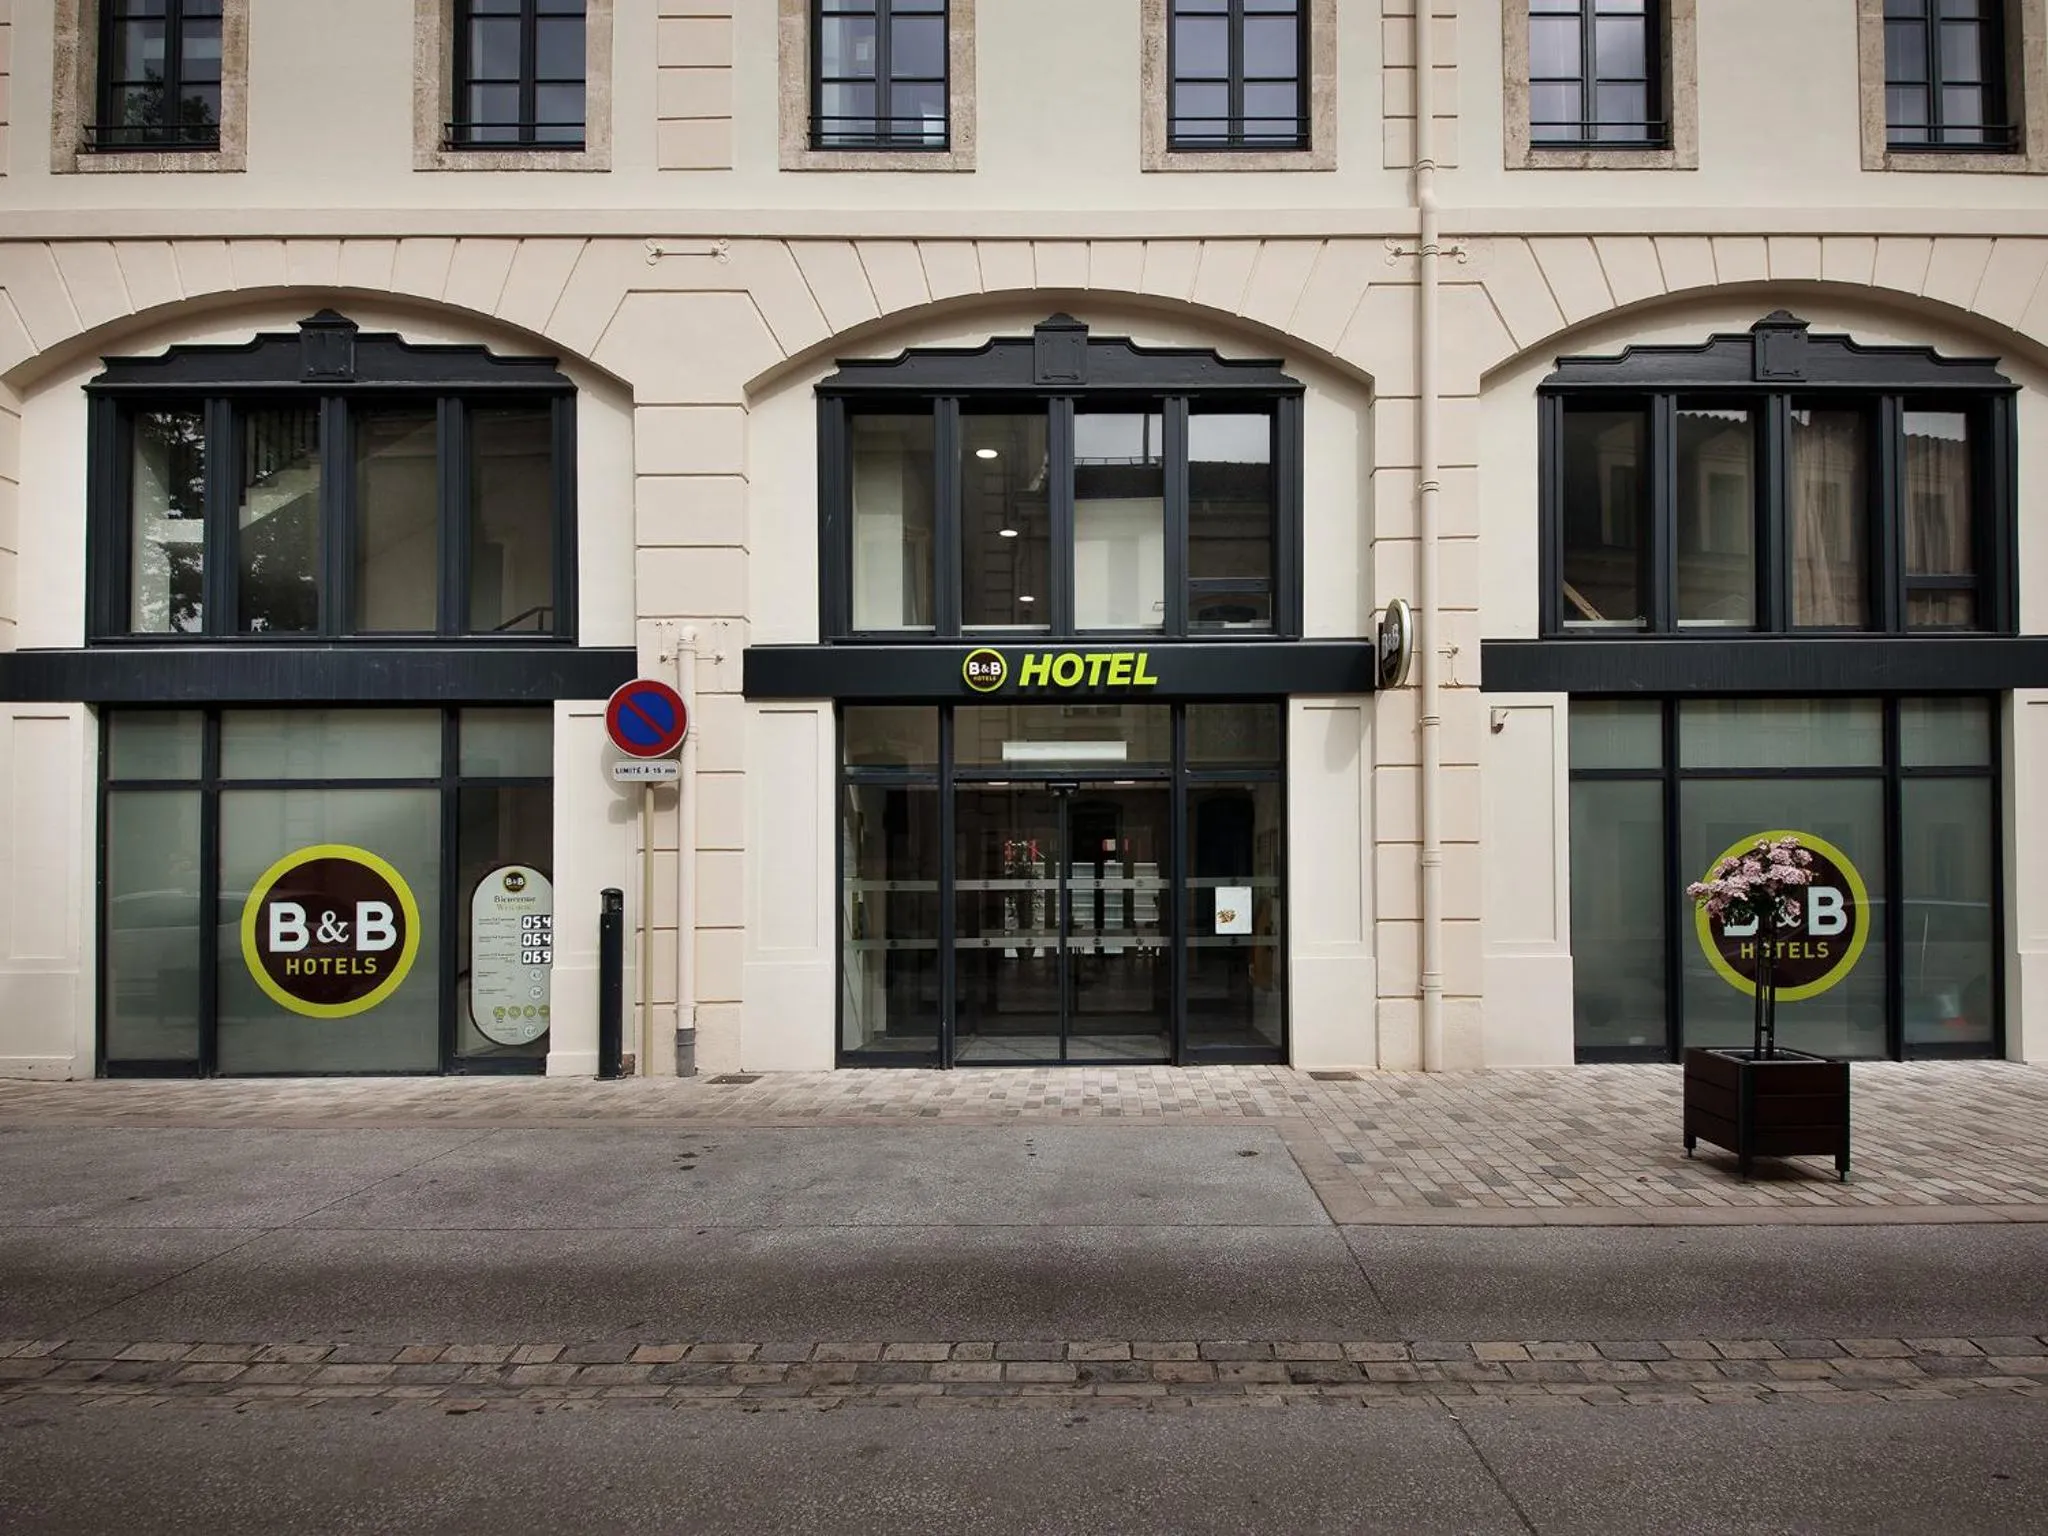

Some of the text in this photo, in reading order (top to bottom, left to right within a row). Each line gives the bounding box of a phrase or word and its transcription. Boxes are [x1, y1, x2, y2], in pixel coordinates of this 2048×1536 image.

[968, 661, 1002, 676] B&B
[1018, 652, 1158, 687] HOTEL
[505, 877, 525, 886] B&B
[269, 900, 397, 953] B&B
[522, 915, 551, 929] 054
[522, 933, 552, 946] 064
[522, 951, 551, 964] 069
[286, 957, 378, 976] HOTELS
